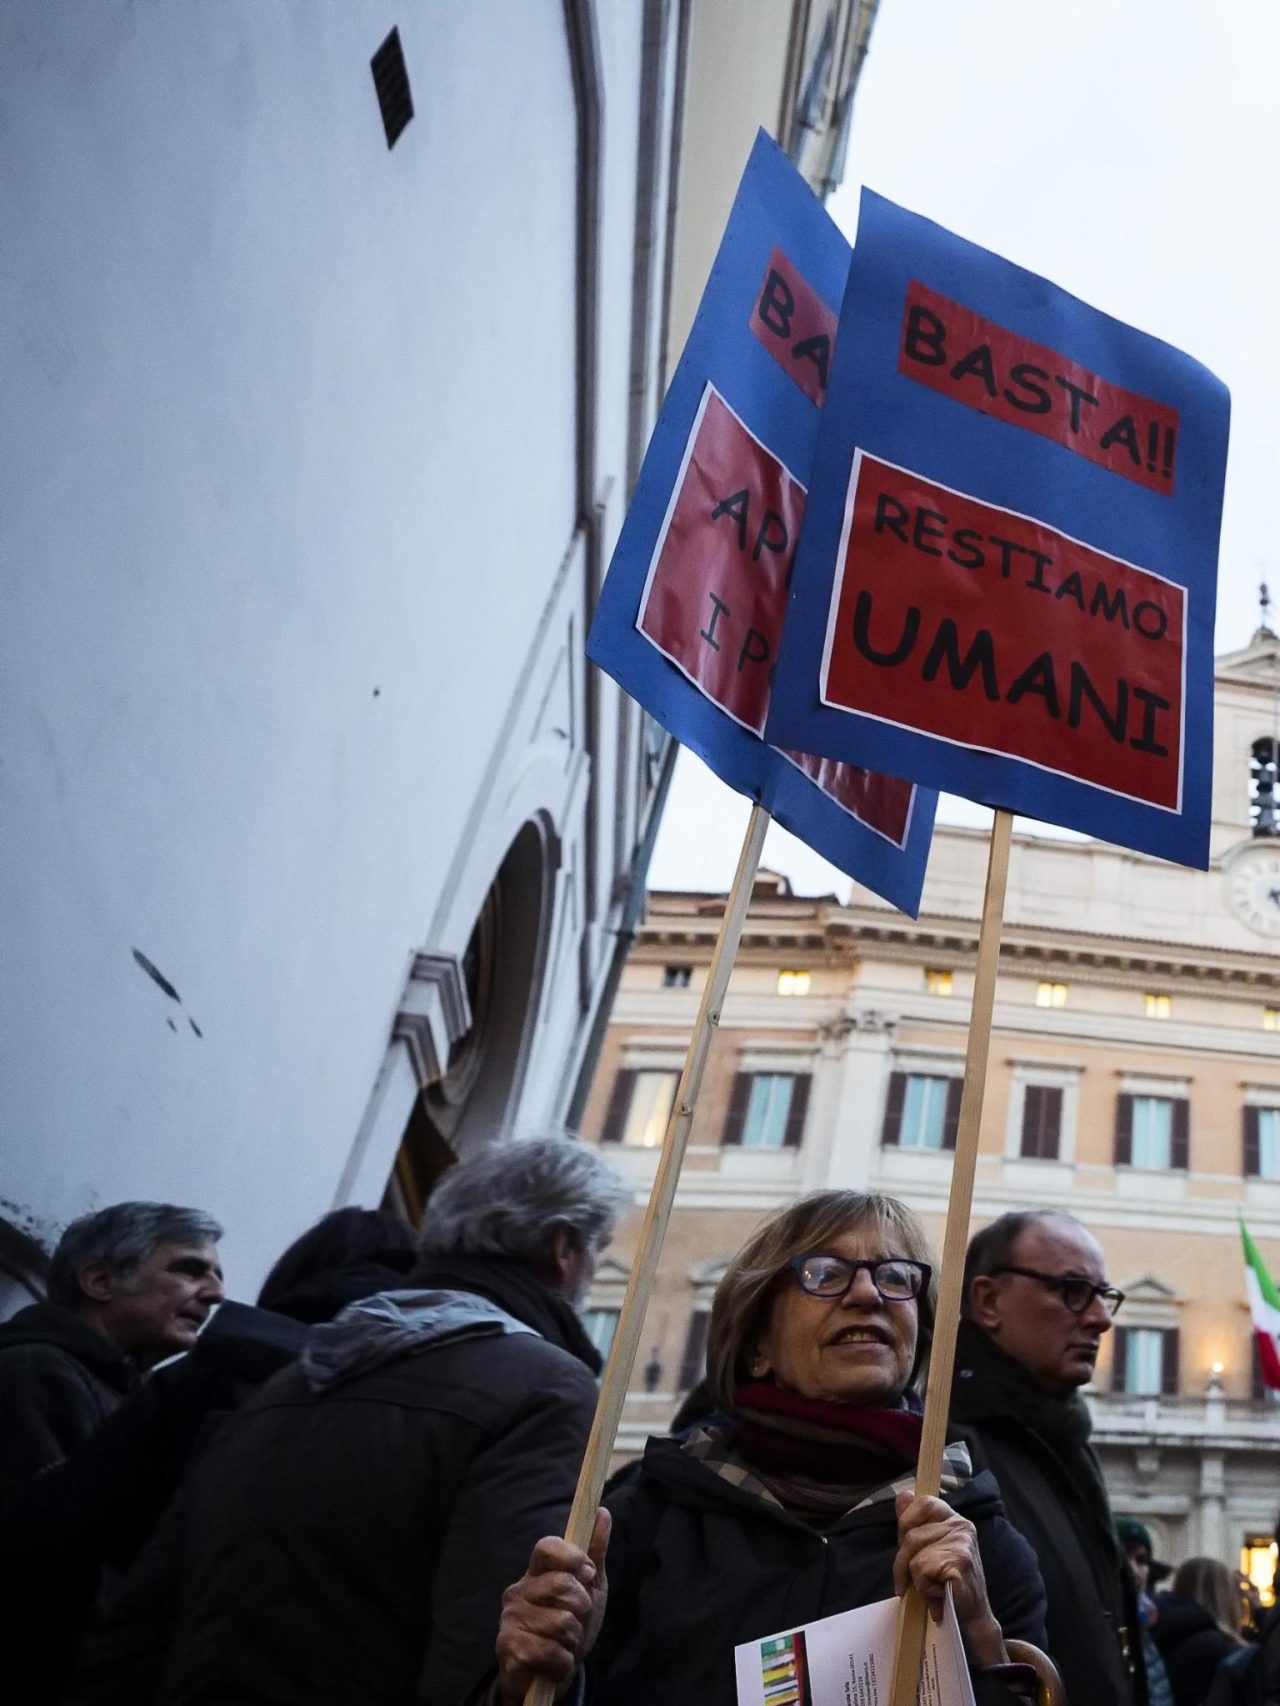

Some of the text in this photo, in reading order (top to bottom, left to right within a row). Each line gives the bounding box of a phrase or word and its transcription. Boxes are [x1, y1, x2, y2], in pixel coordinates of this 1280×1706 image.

[903, 304, 1177, 480] BASTA!!
[873, 493, 1168, 640] RESTIAMO
[852, 590, 1171, 757] UMANI
